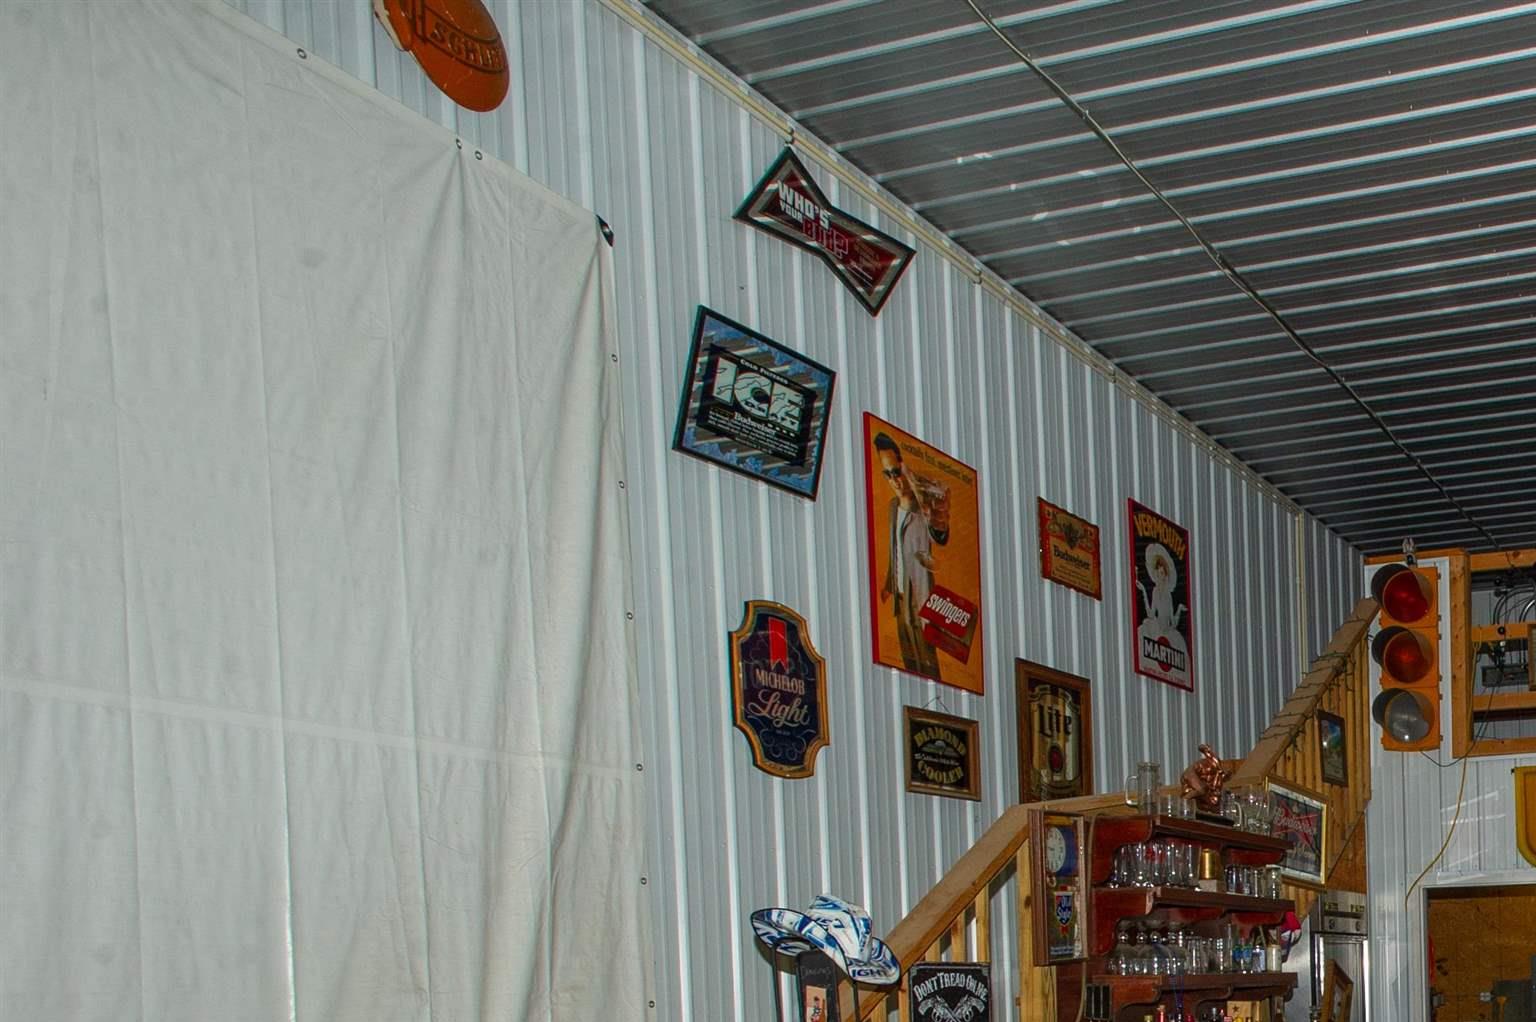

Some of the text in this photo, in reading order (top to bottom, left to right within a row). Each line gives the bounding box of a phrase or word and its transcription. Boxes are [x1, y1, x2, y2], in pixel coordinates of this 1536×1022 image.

[777, 179, 831, 230] WHO'S
[780, 202, 803, 223] YOUR
[734, 411, 777, 436] Budweiser
[1134, 512, 1186, 561] VERMOUTH
[1053, 544, 1090, 570] Budweiser
[926, 594, 971, 627] swingers
[1144, 639, 1184, 671] MARTINI
[755, 668, 805, 696] MICHELOB
[748, 689, 811, 728] Light
[1037, 702, 1072, 738] Lite
[914, 726, 967, 756] DIAMOND
[917, 760, 964, 784] COOLER
[937, 972, 965, 989] TREAD
[966, 975, 977, 993] ON
[976, 982, 988, 1002] ME
